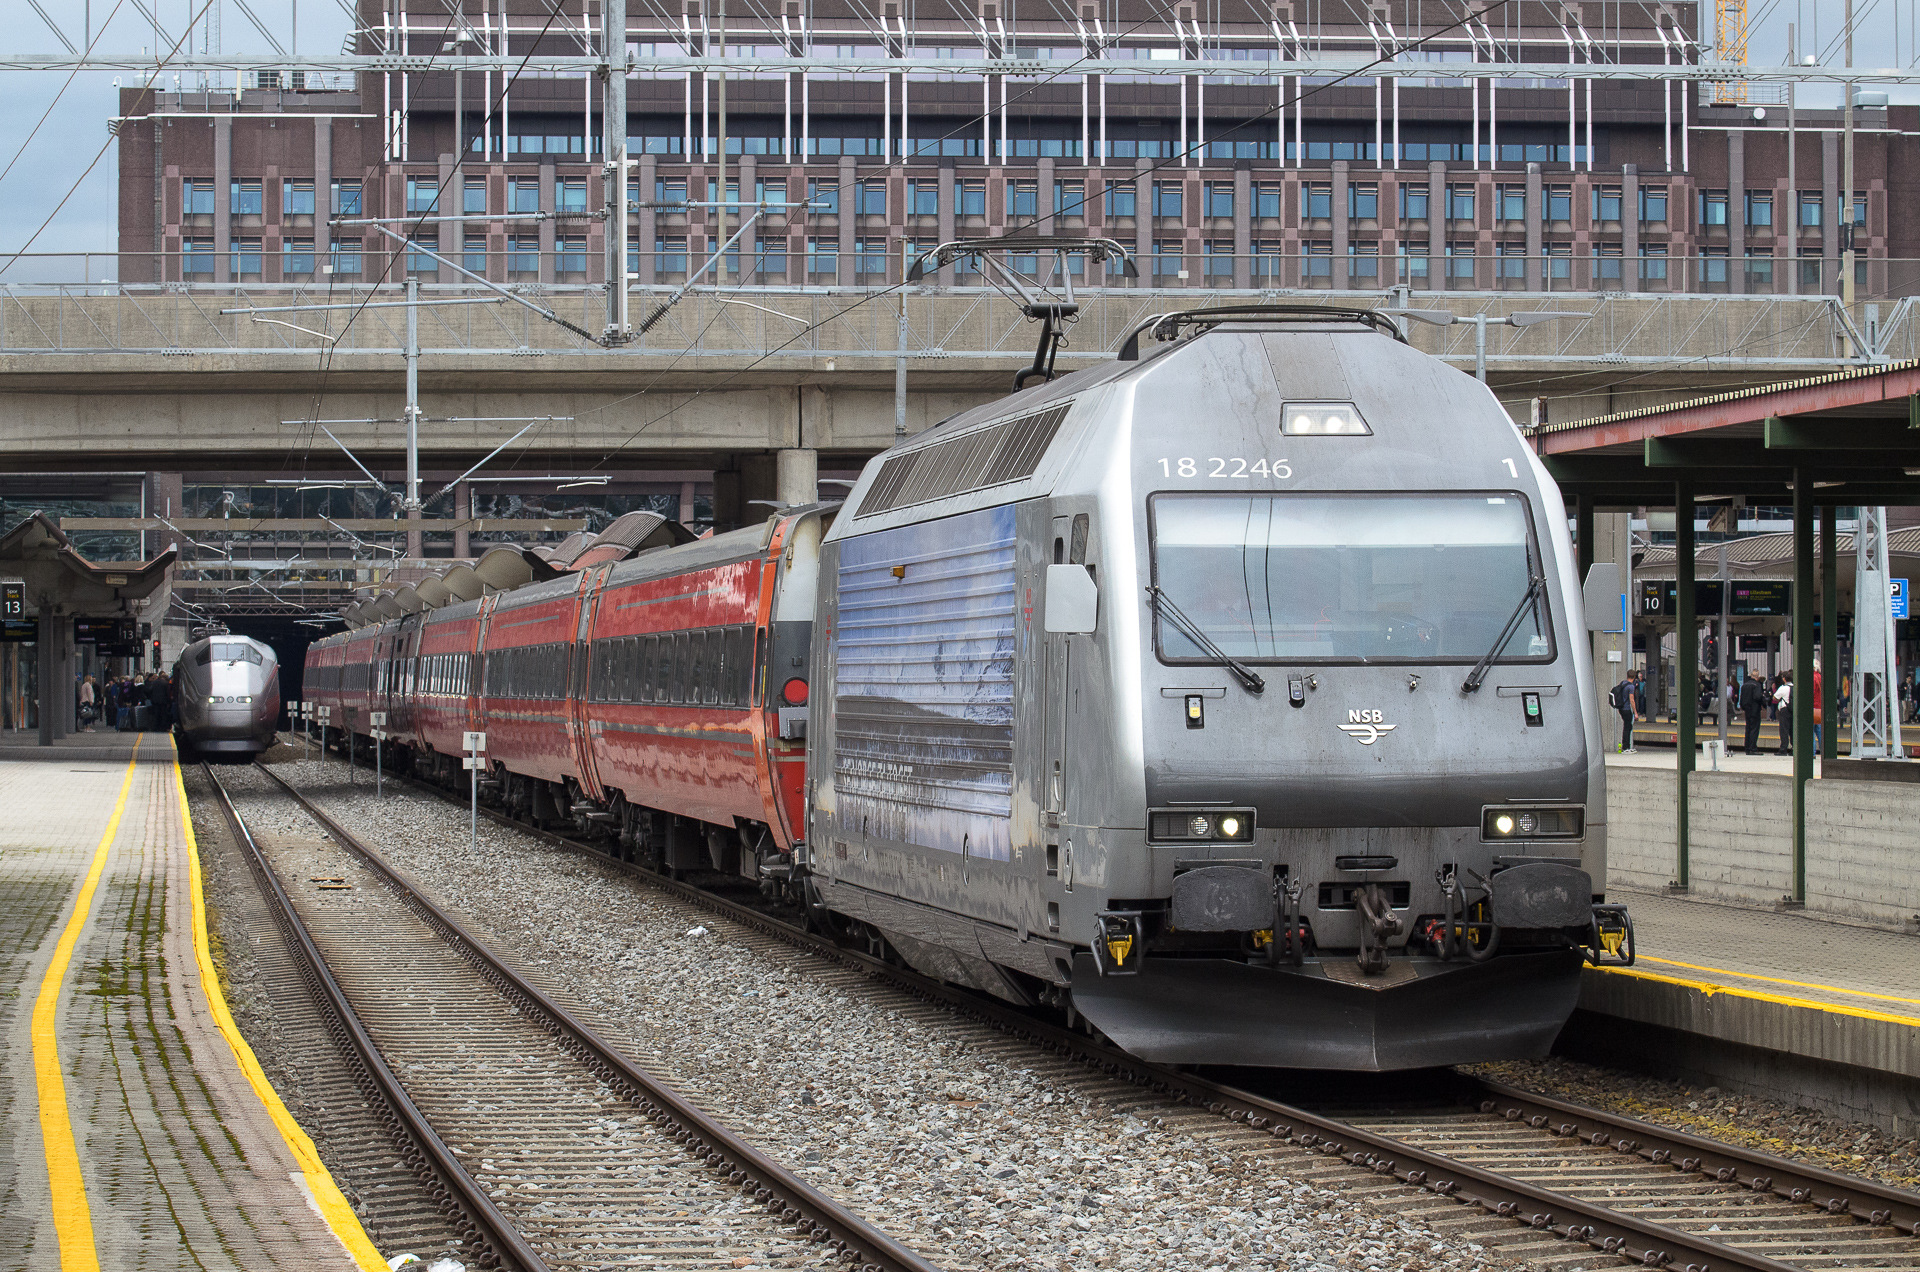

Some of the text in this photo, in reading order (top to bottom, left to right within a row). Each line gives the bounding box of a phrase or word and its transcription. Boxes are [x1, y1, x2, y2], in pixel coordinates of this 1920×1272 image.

[1158, 457, 1293, 479] 18 2246
[1501, 457, 1519, 478] 1
[5, 601, 21, 614] 13
[1644, 597, 1660, 610] 10
[123, 630, 134, 640] 13
[132, 646, 141, 654] 13
[1348, 709, 1383, 723] NSB
